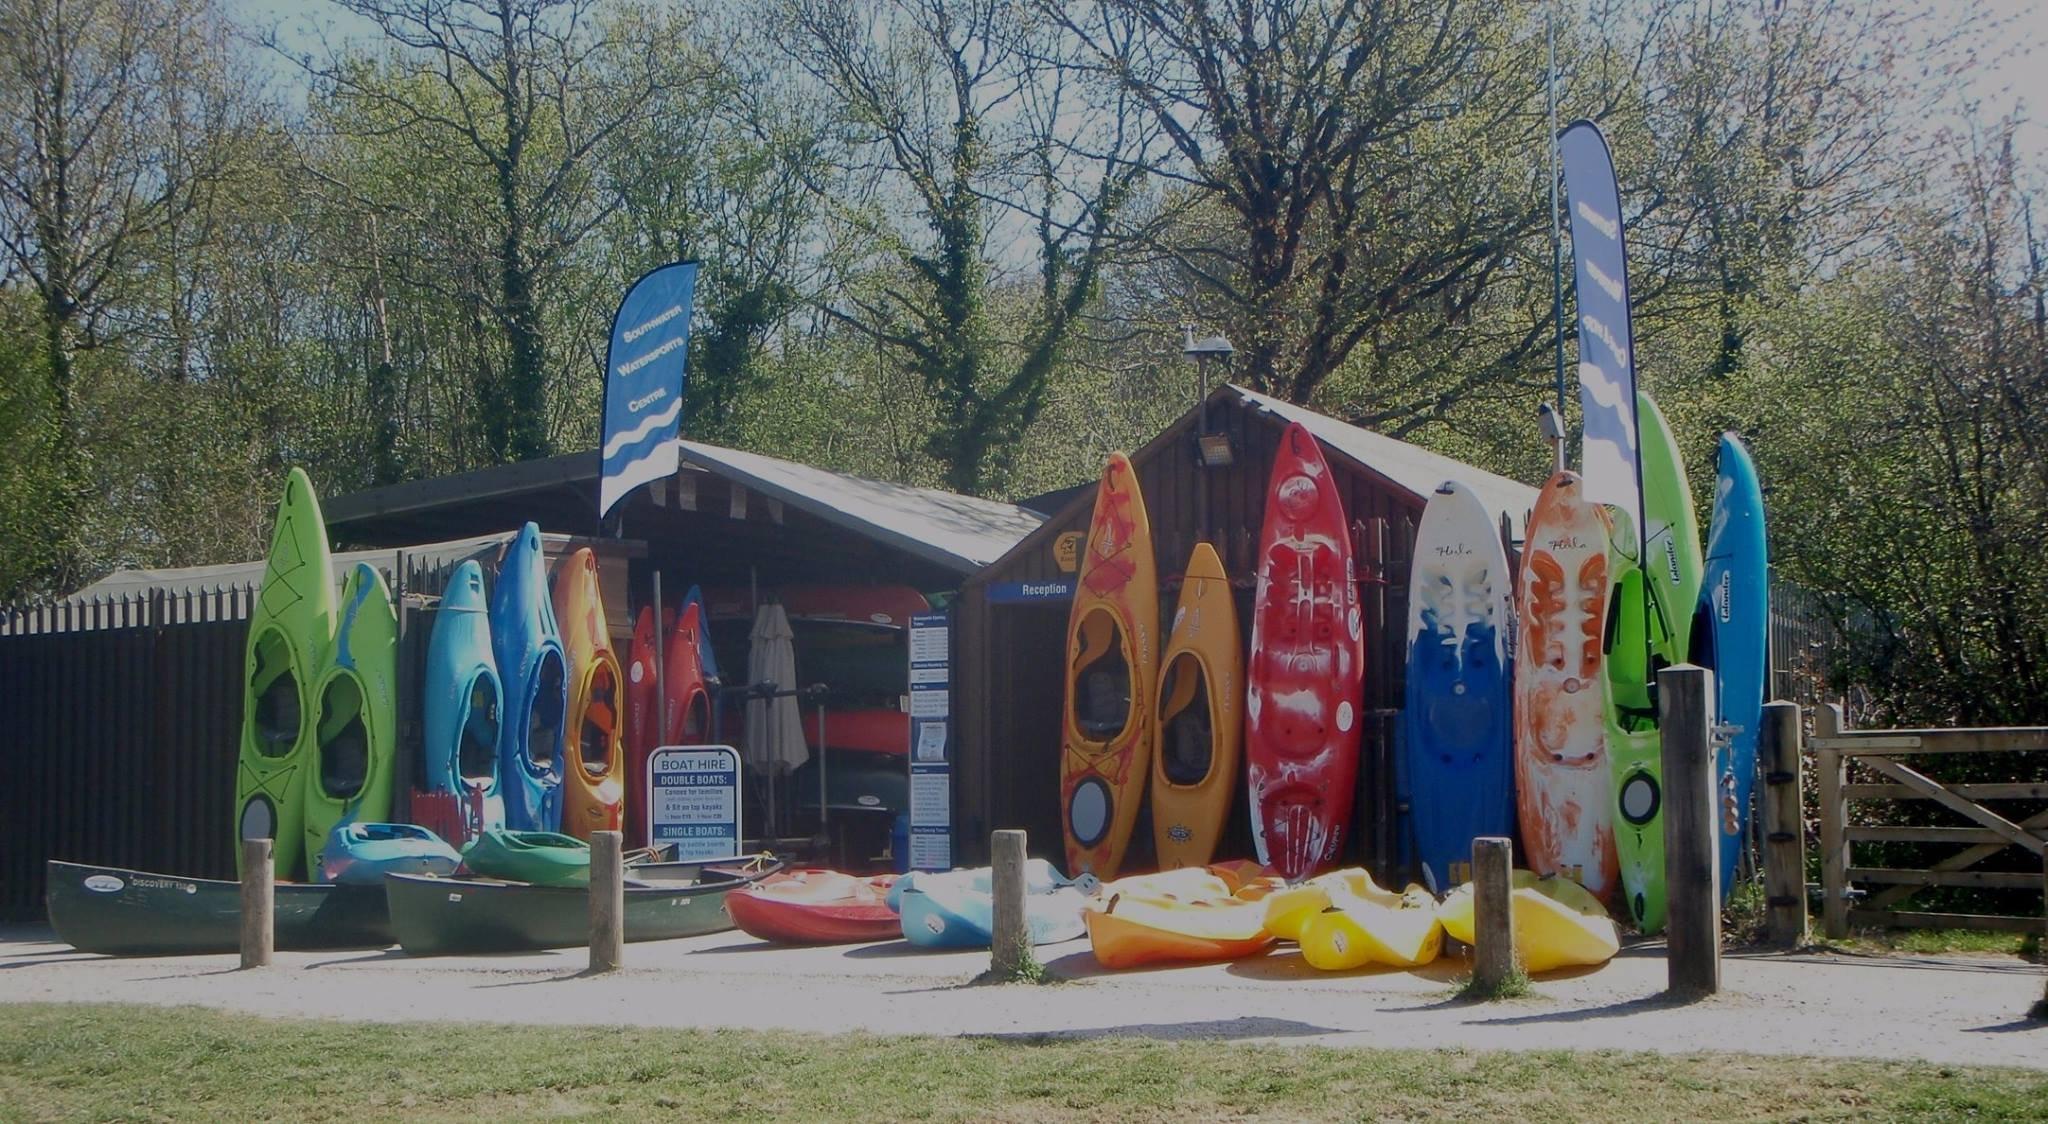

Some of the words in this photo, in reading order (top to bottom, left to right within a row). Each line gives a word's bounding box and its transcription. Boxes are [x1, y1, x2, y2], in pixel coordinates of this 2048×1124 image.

[1022, 583, 1067, 597] Reception
[661, 759, 694, 770] BOAT
[698, 759, 726, 770] HIRE
[661, 775, 695, 785] DOUBLE
[697, 775, 727, 785] BOATS:
[663, 827, 695, 837] SINGLE
[696, 827, 726, 837] BOATS:
[132, 878, 174, 889] DISCOVERY
